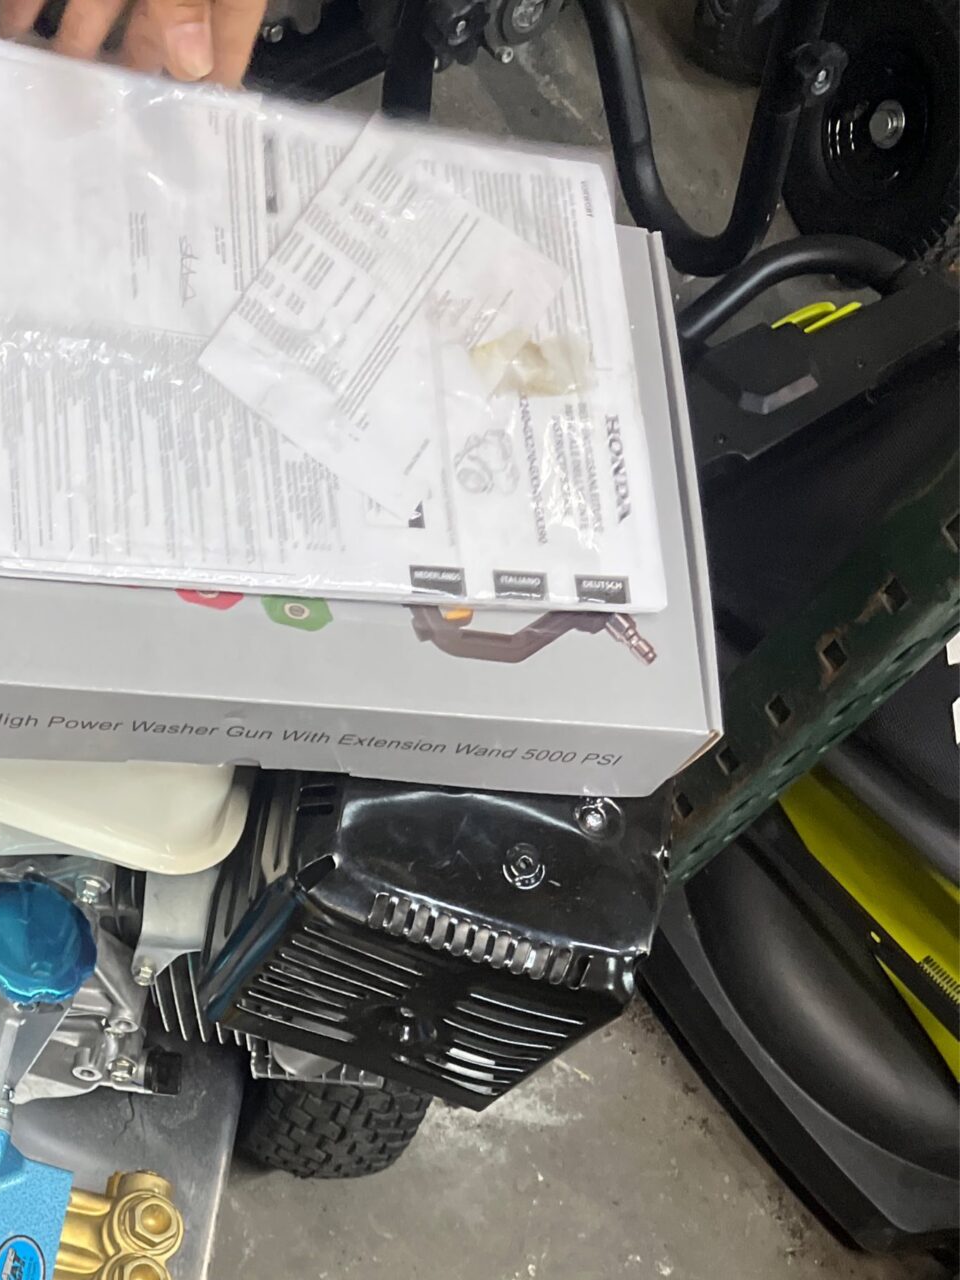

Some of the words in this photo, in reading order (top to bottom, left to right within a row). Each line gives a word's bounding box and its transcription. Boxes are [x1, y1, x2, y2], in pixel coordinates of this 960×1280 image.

[605, 414, 632, 524] HONDA
[500, 575, 541, 586] ITALIANO
[582, 580, 623, 590] DEUTSCH
[47, 716, 123, 732] Power
[131, 720, 218, 737] Washer
[226, 725, 273, 741] Gun
[282, 729, 330, 744] With
[338, 733, 447, 753] Extension
[454, 742, 518, 759] Wand
[522, 748, 576, 764] 5000
[581, 753, 623, 767] PSI
